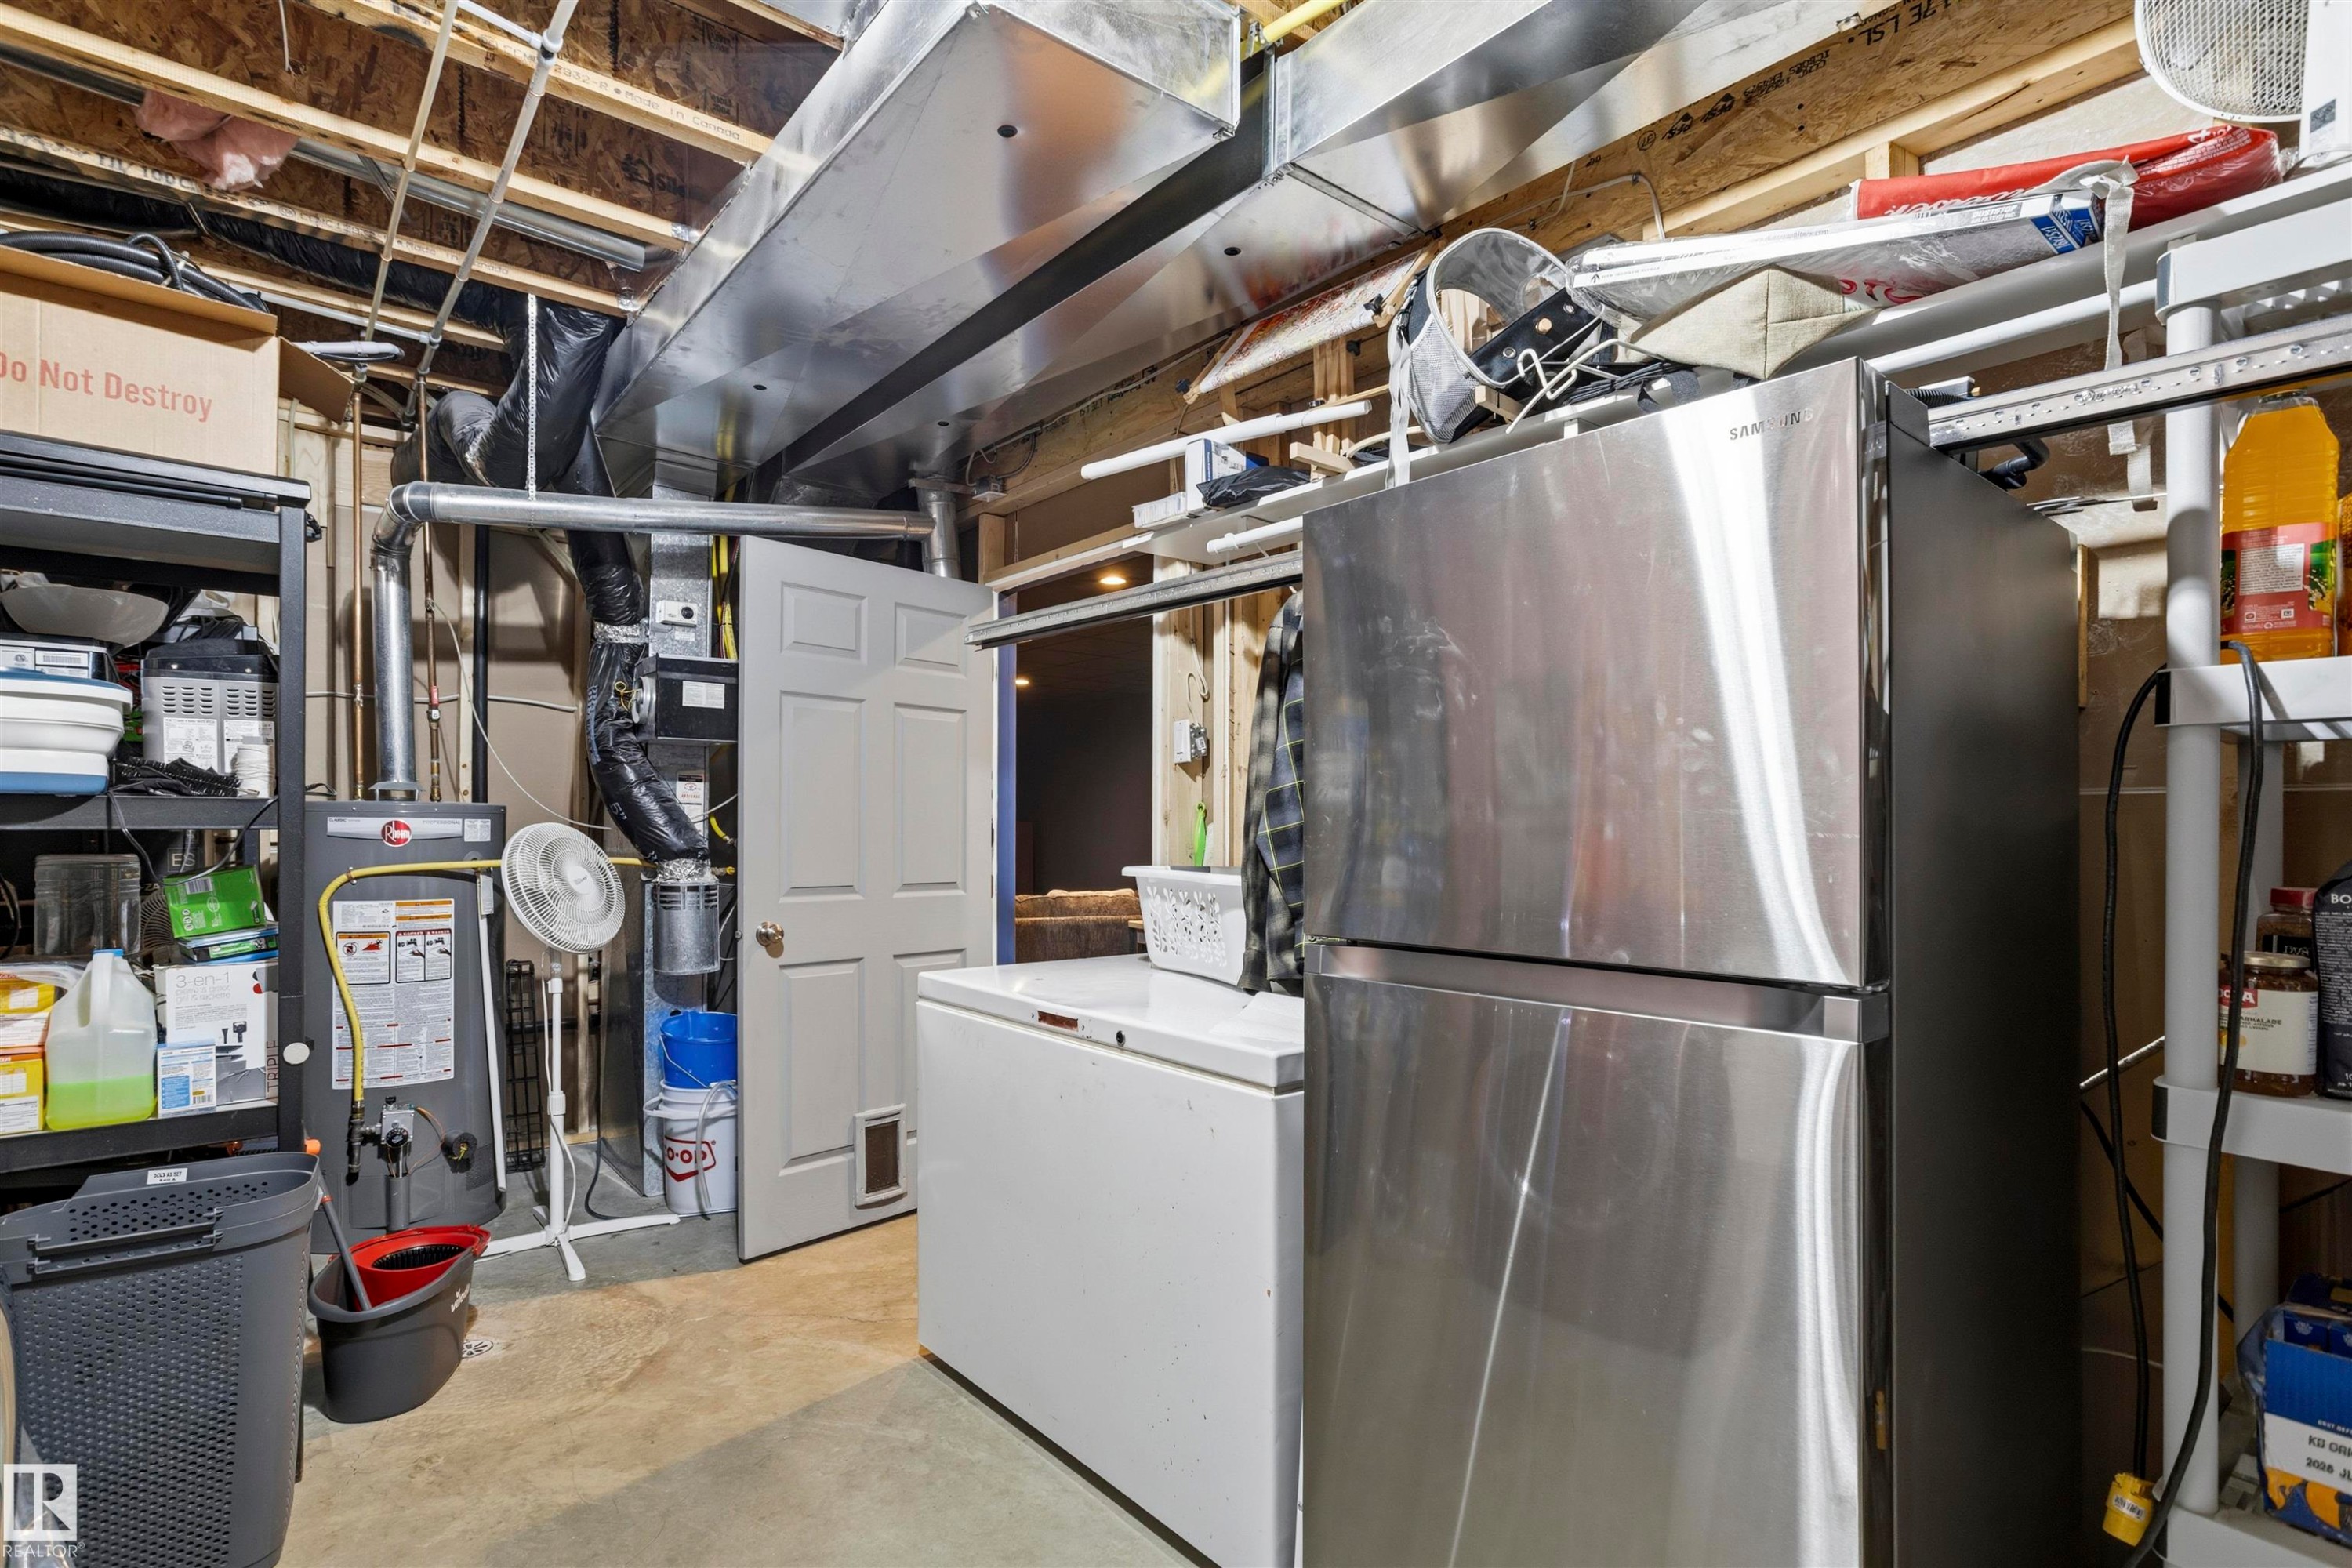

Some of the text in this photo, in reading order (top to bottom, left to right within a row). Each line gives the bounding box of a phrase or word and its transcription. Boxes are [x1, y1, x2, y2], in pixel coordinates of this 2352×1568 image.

[625, 89, 660, 111] Made
[692, 116, 740, 140] Canada
[39, 358, 94, 396] Not
[104, 372, 213, 423] Destroy
[1729, 407, 1814, 441] SAMSUNG
[175, 971, 230, 989] 3-en-1
